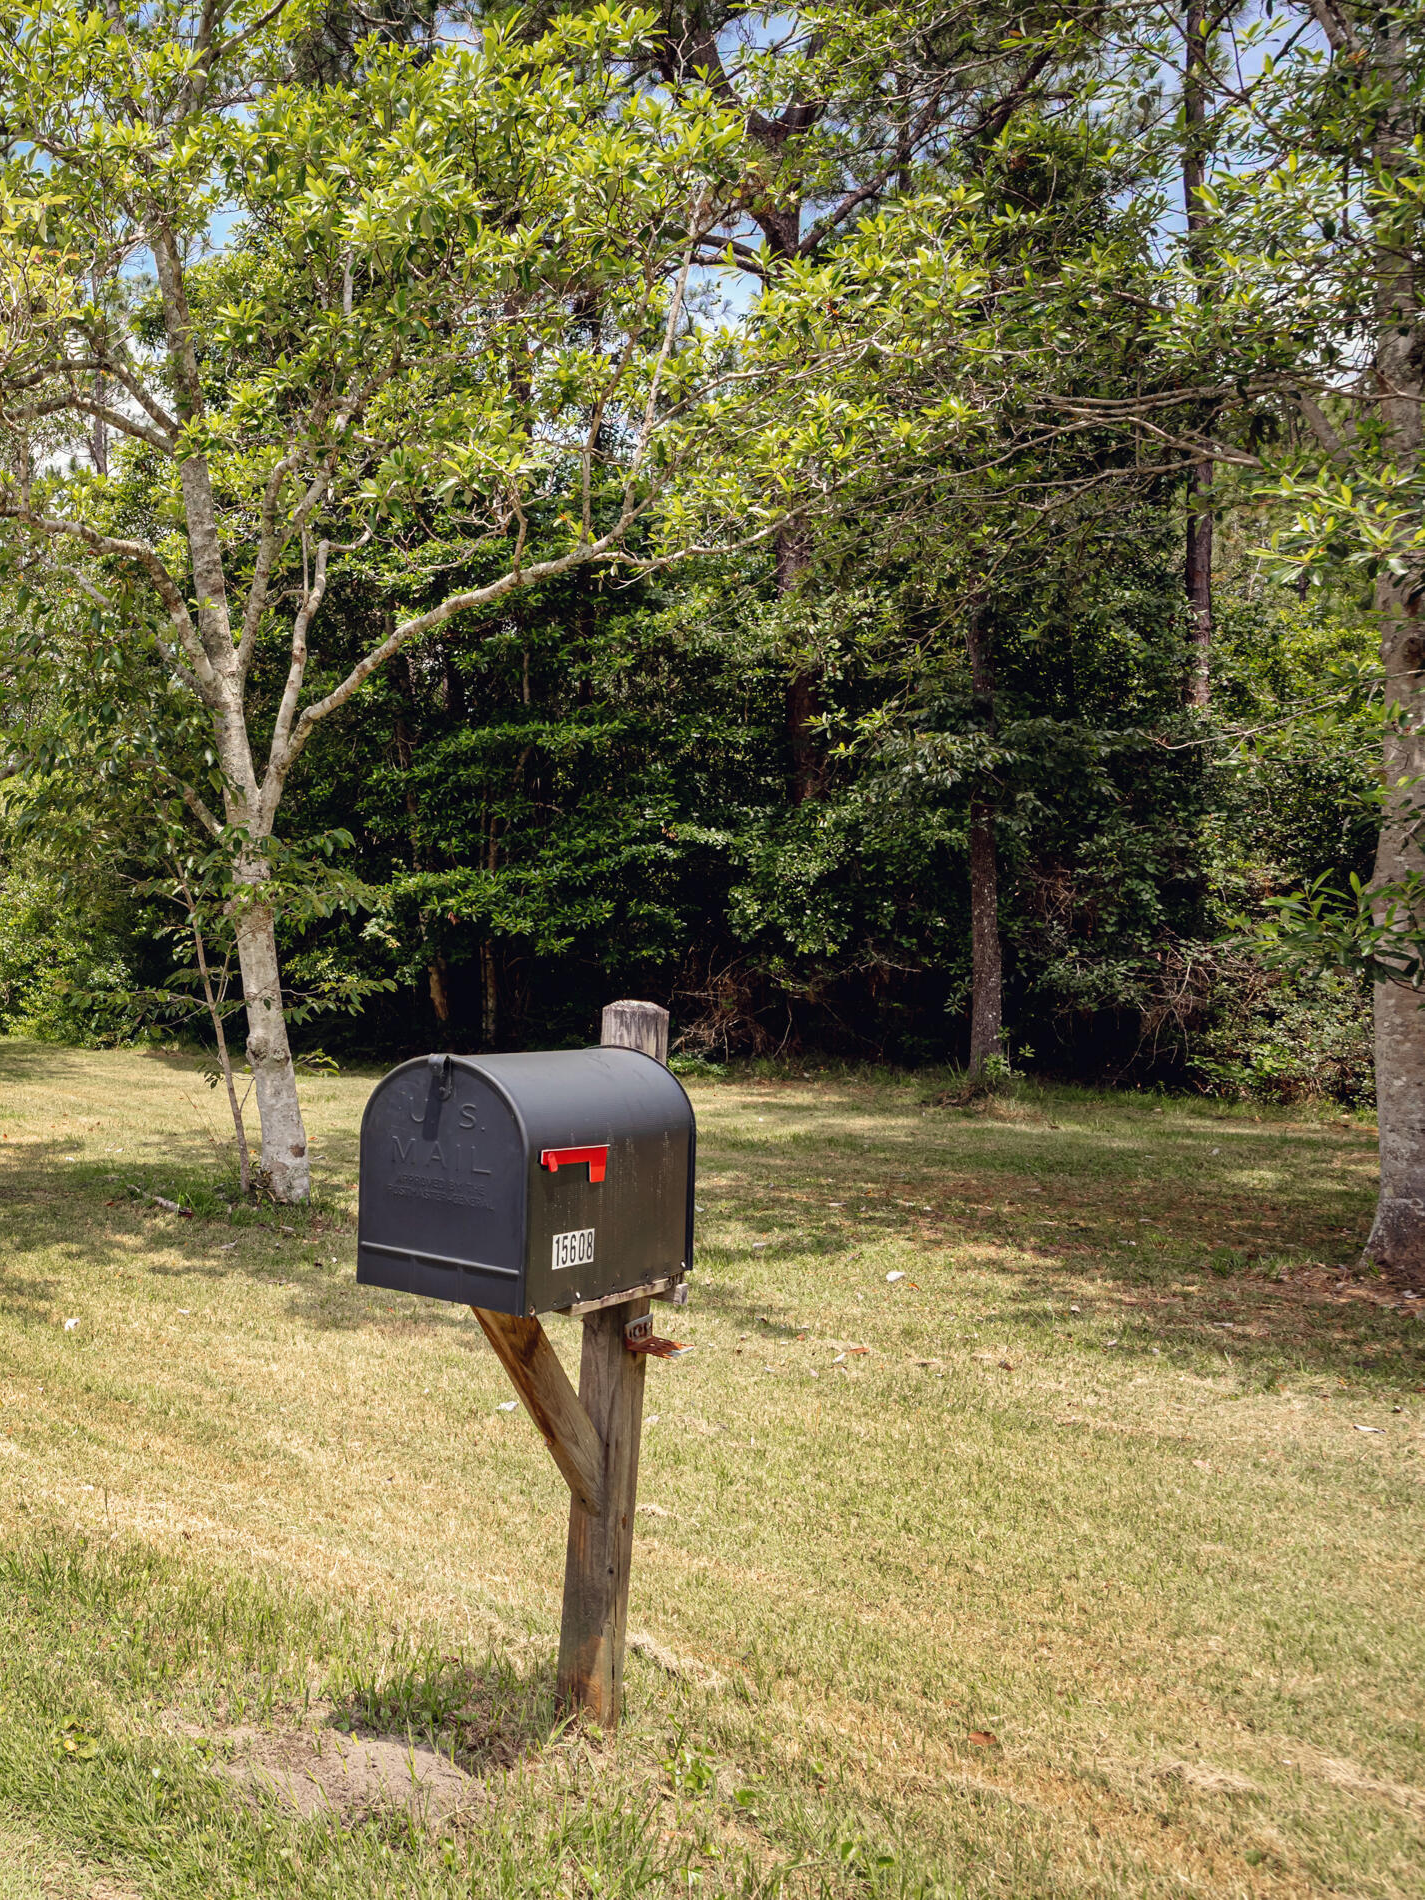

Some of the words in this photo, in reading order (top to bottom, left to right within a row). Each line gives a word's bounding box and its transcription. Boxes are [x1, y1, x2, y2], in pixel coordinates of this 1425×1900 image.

[390, 1131, 493, 1176] MAIL
[397, 1172, 447, 1190] APPROVED
[448, 1178, 464, 1191] BY
[555, 1231, 592, 1267] 15608
